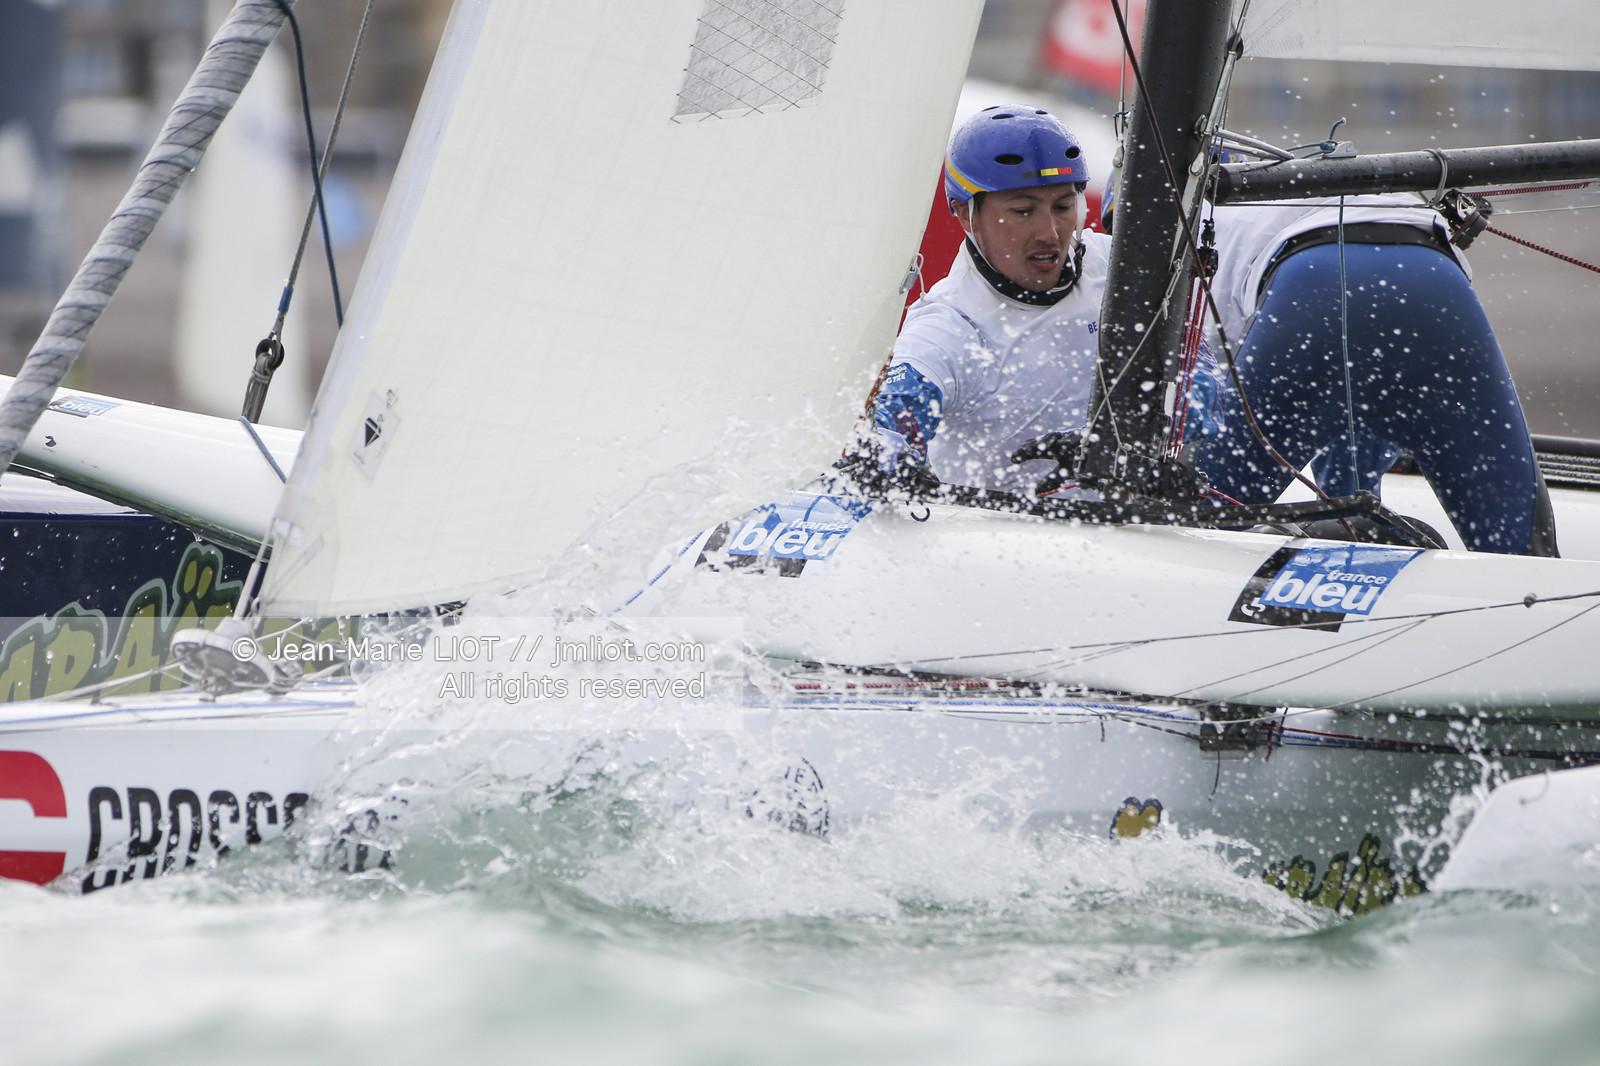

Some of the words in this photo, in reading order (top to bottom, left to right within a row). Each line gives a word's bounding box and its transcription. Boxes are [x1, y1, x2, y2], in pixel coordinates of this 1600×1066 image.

[730, 520, 837, 557] bleu
[789, 519, 849, 532] france
[1265, 570, 1380, 611] bleu
[1327, 570, 1387, 585] france
